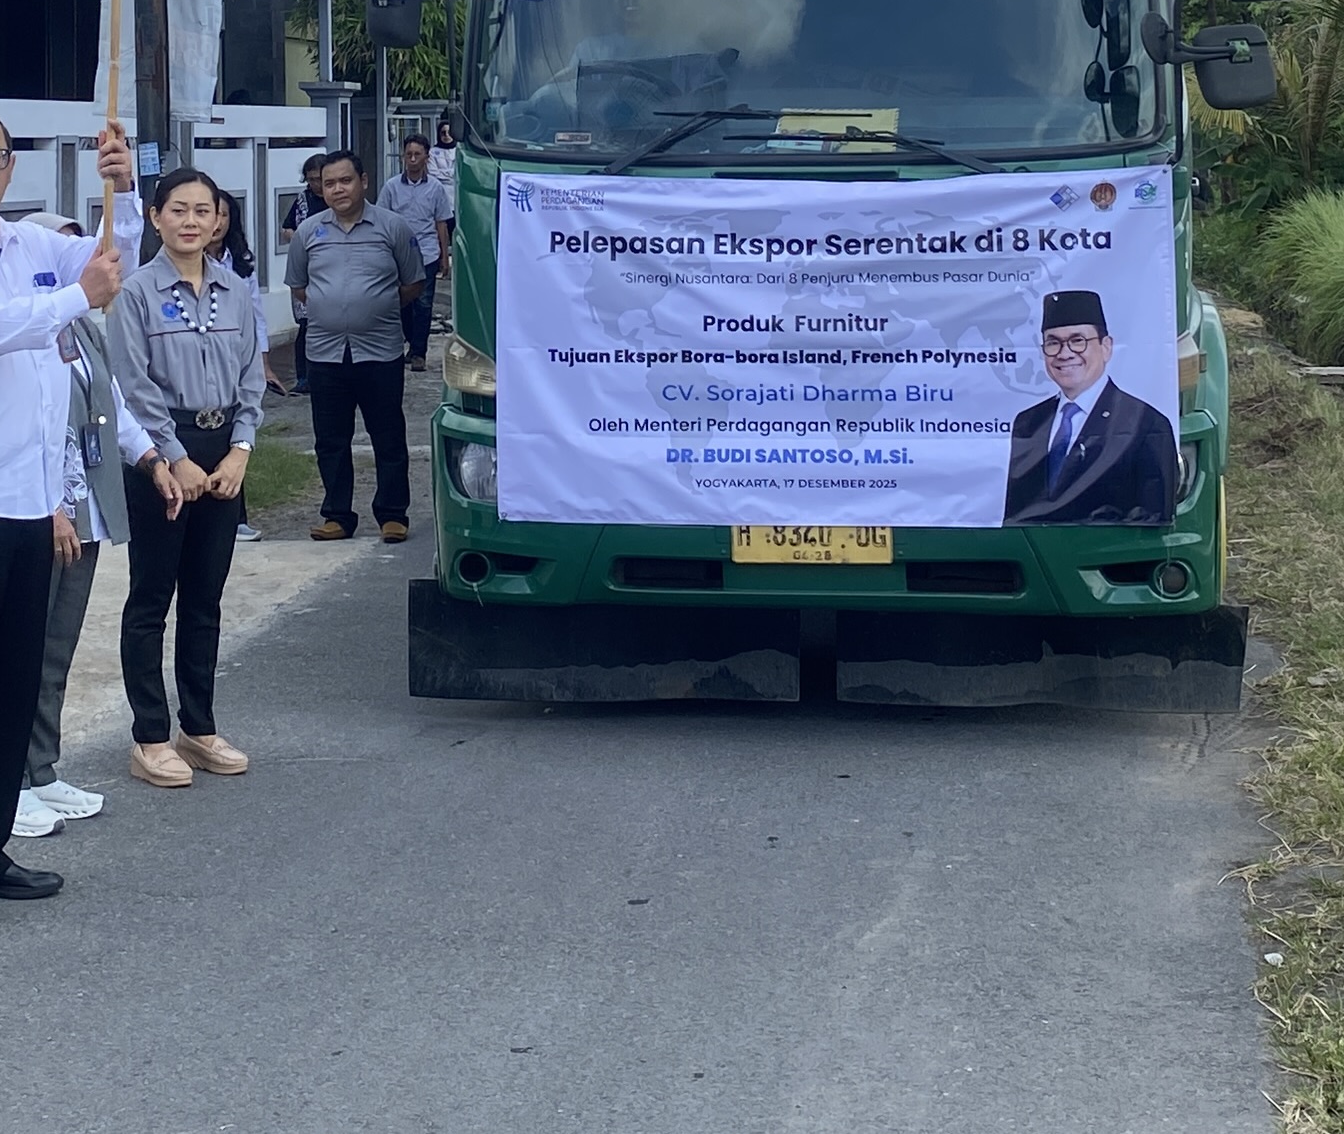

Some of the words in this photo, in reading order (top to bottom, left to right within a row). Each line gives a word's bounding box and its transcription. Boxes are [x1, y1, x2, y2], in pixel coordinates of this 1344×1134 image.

[550, 230, 705, 261] Pelepasan
[713, 233, 817, 262] Ekspor
[825, 230, 967, 255] Serentak
[974, 226, 1004, 253] di
[1011, 227, 1030, 252] 8
[1038, 226, 1113, 251] Kota
[675, 273, 753, 284] Nusantara:
[756, 272, 786, 284] Dari
[788, 273, 798, 284] 8
[801, 272, 855, 287] Penjuru
[858, 271, 940, 283] Menembus
[942, 271, 982, 283] Pasar
[703, 315, 785, 332] Produk
[795, 313, 889, 332] Furnitur
[548, 348, 611, 367] Tujuan
[614, 349, 679, 368] Ekspor
[681, 349, 779, 364] Bora-bora
[782, 349, 848, 366] Island,
[851, 349, 918, 364] French
[921, 347, 1017, 368] Polynesia
[662, 384, 700, 401] CV.
[706, 383, 795, 406] Sorajati
[802, 384, 897, 402] Dharma
[905, 383, 954, 402] Biru
[588, 417, 629, 432] Oleh
[634, 417, 702, 432] Menteri
[706, 417, 831, 437] Perdagangan
[835, 417, 916, 436] Republik
[919, 417, 1012, 433] Indonesia
[666, 448, 700, 464] DR.
[703, 448, 751, 464] BUDI
[755, 448, 860, 466] SANTOSO,
[863, 447, 915, 465] M.Si.
[695, 478, 781, 490] YOGYAKARTA,
[783, 478, 795, 489] 17
[798, 478, 866, 489] DESEMBER
[868, 478, 898, 489] 2025
